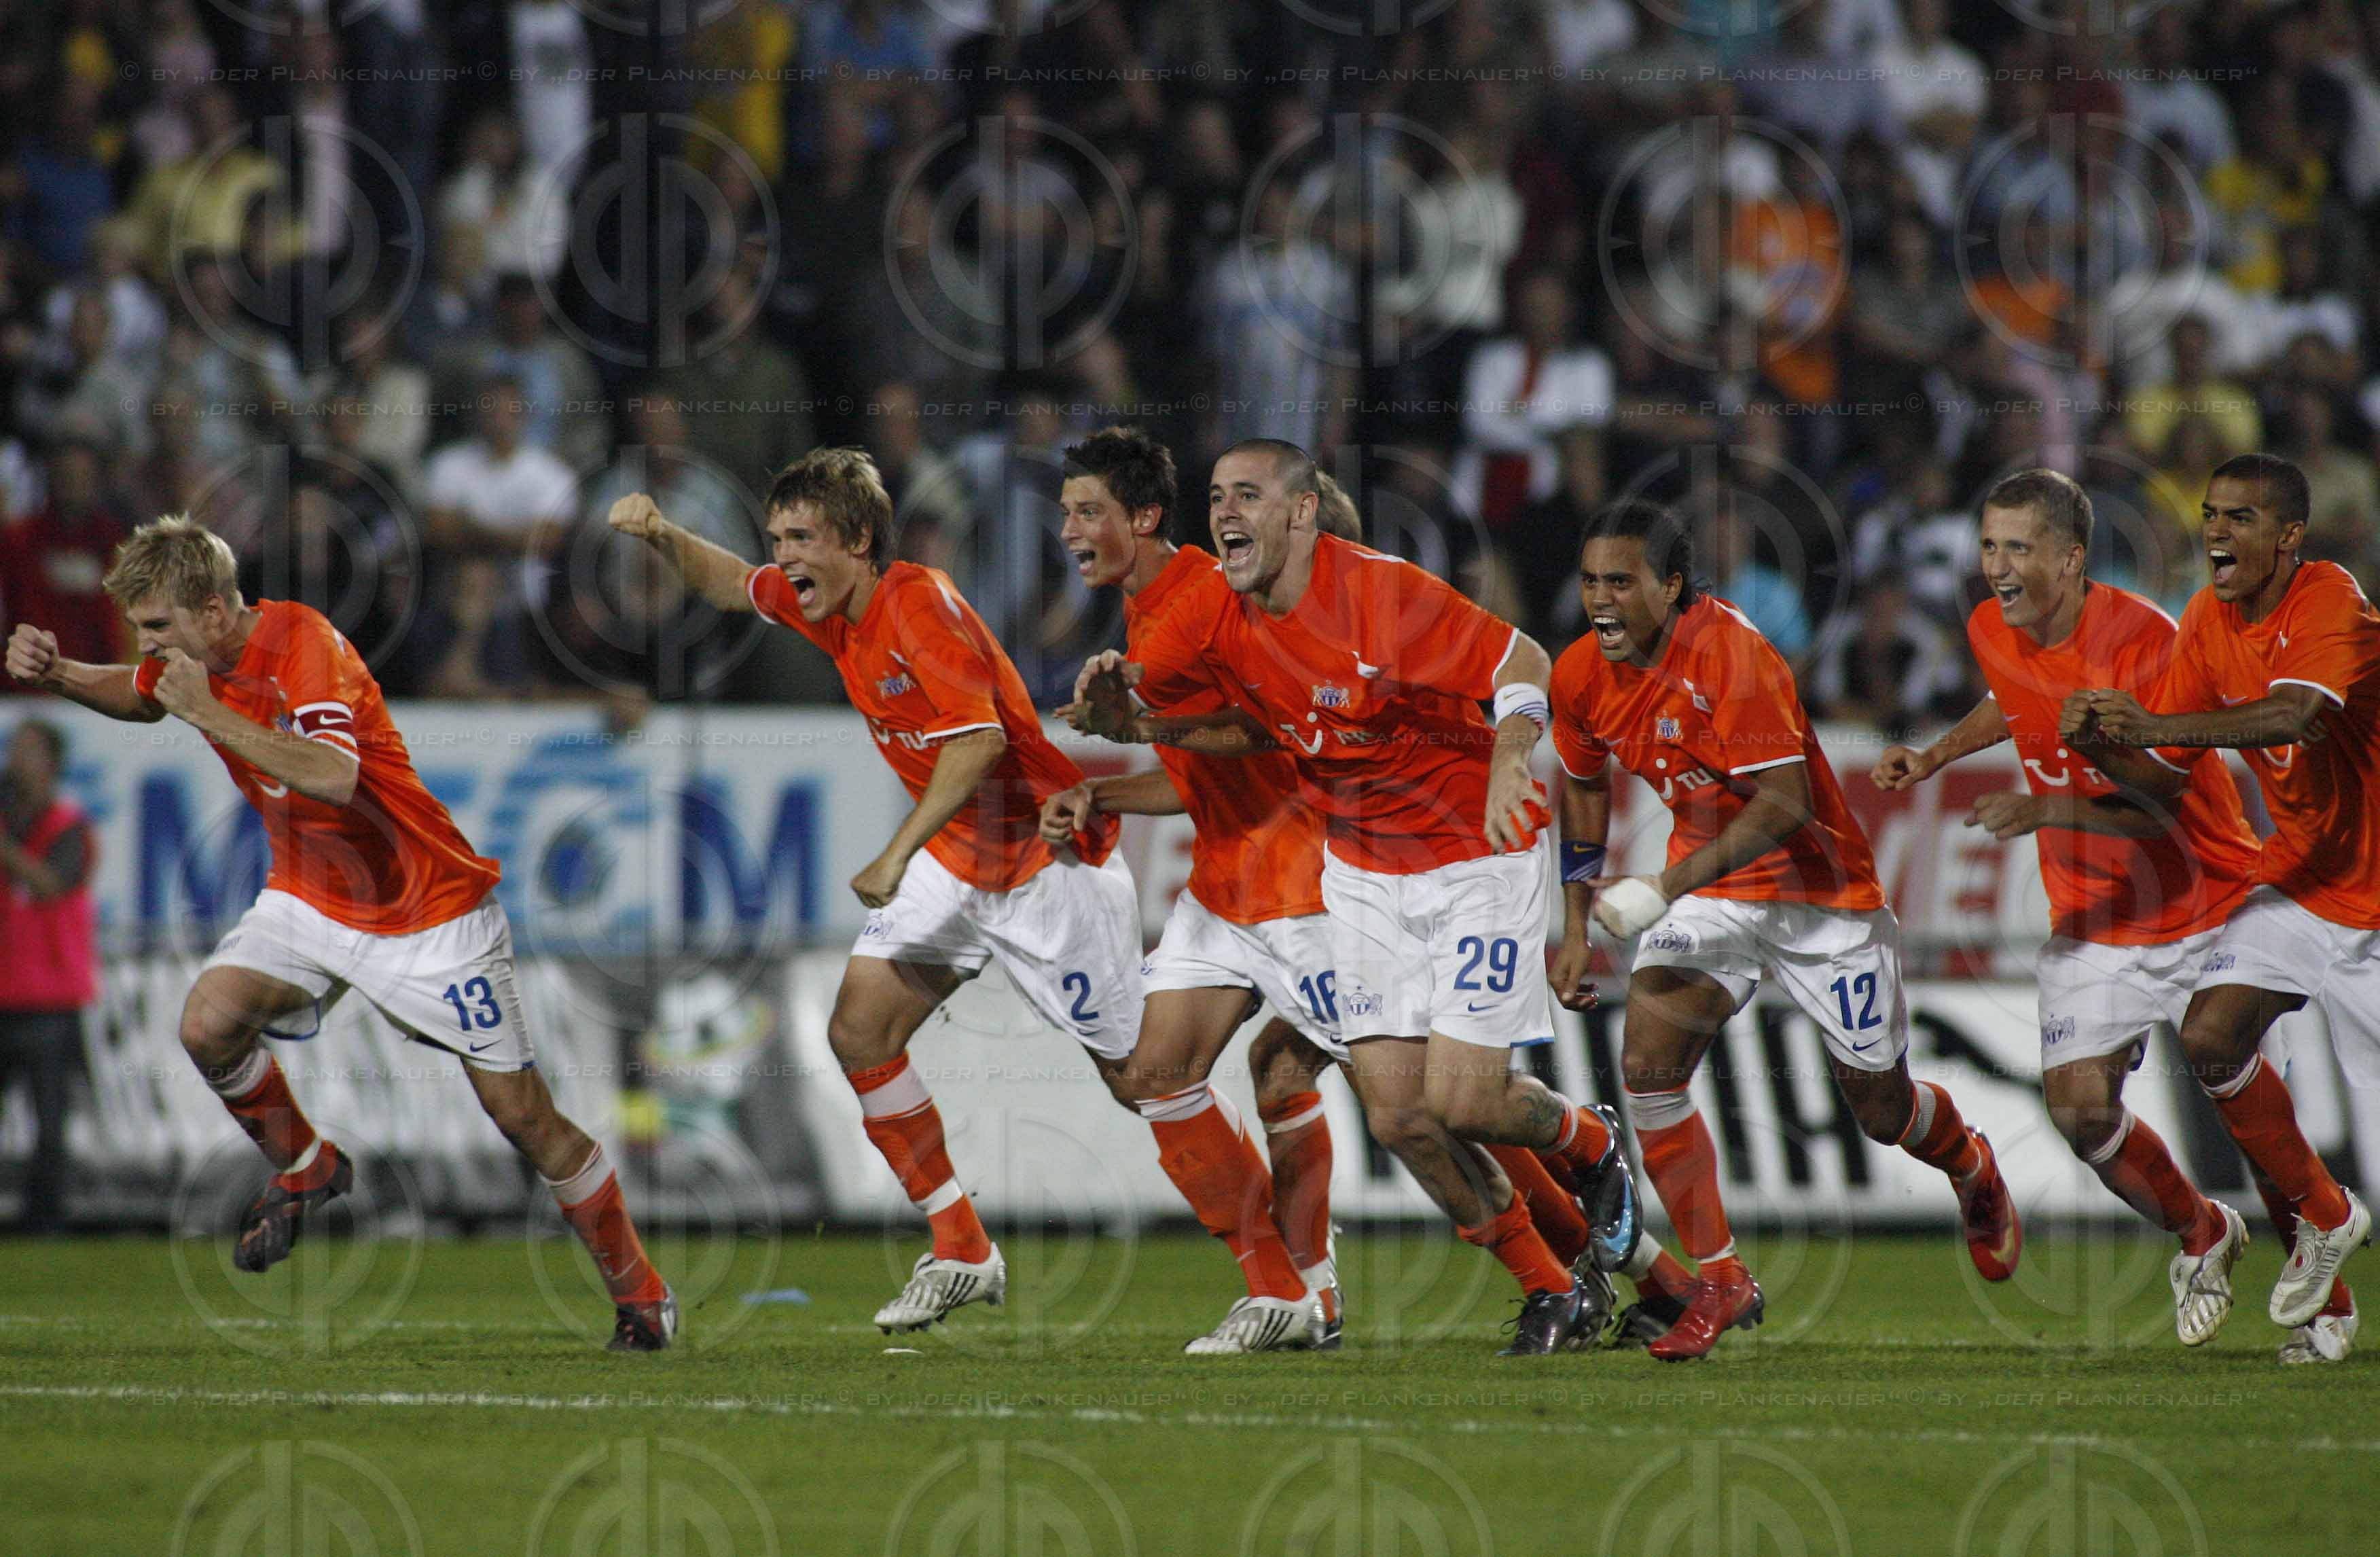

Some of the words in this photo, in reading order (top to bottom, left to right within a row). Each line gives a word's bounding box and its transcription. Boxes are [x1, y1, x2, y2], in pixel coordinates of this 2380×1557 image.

[1454, 935, 1519, 993] 29
[443, 976, 502, 1031] 13
[1062, 971, 1100, 1021] 2
[1830, 972, 1883, 1030] 12
